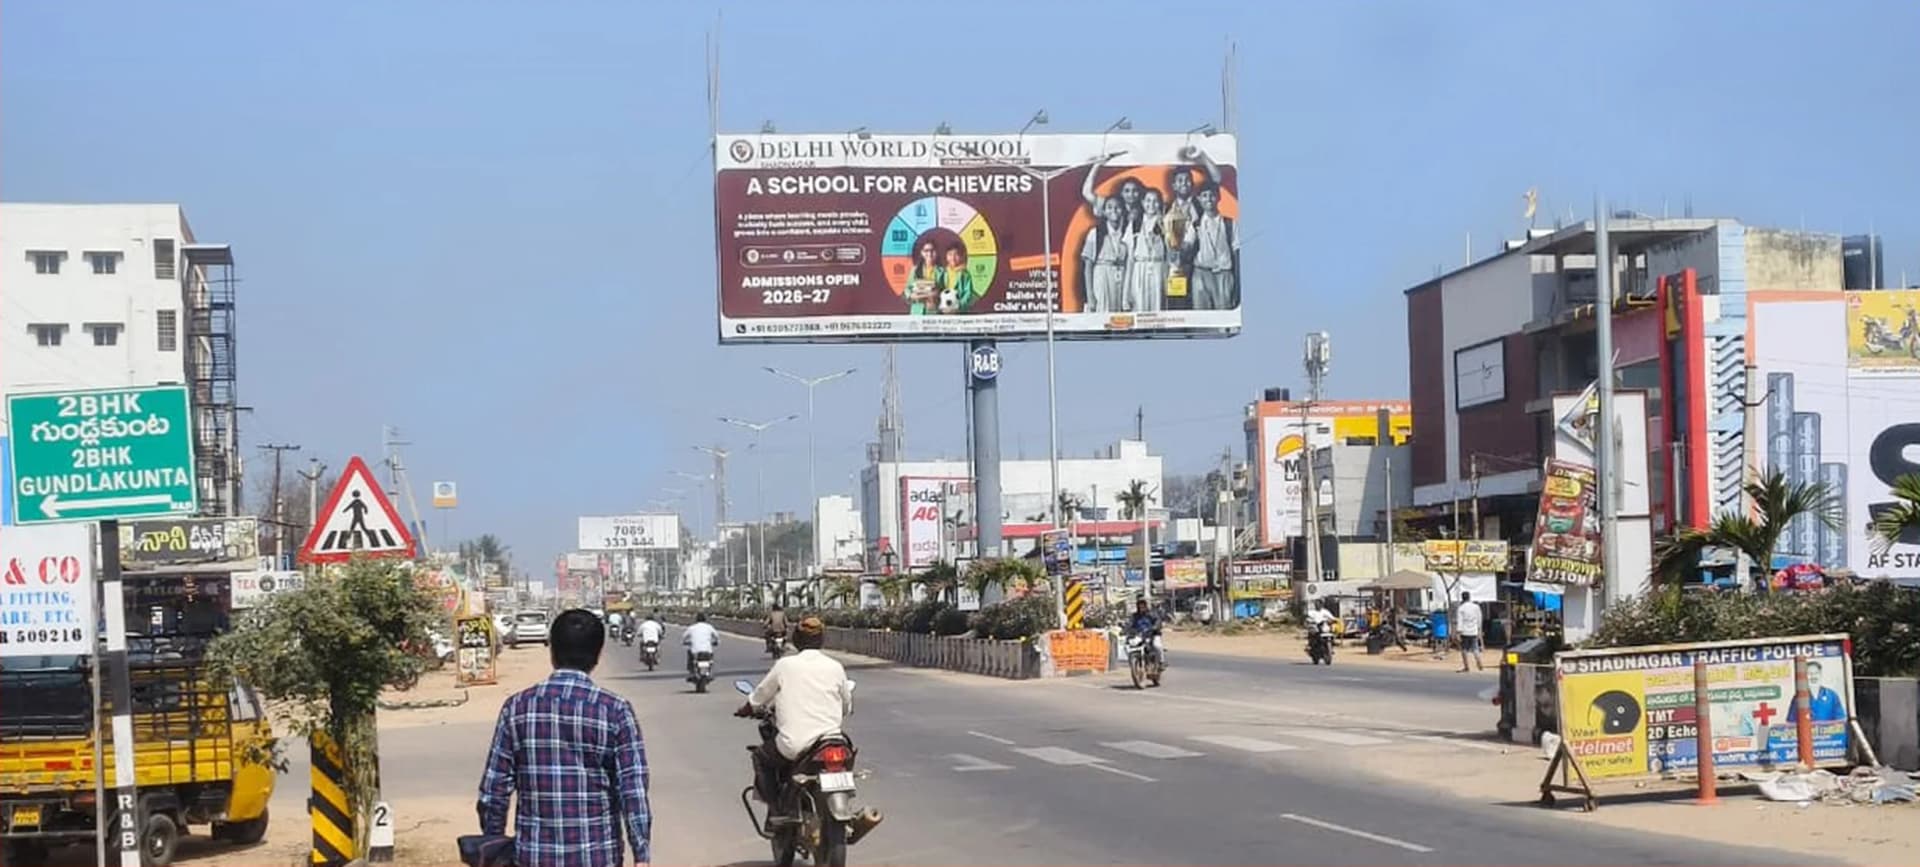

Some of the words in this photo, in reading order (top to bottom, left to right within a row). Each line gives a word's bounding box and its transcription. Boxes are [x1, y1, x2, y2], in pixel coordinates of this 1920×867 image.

[759, 140, 834, 158] DELHI
[840, 140, 927, 158] WORLD
[934, 139, 1031, 158] SCHOOL
[747, 177, 763, 195] A
[768, 175, 860, 194] SCHOOL
[864, 175, 907, 193] FOR
[912, 173, 1033, 193] ACHIEVERS
[742, 275, 823, 288] ADMISSIONS
[825, 274, 860, 286] OPEN
[763, 289, 830, 304] 2026-27
[973, 354, 998, 373] R&B
[57, 393, 142, 418] 2BHK
[71, 445, 133, 469] 2BHK
[19, 466, 190, 496] GUNDLAKUNTA
[38, 556, 81, 585] CO
[16, 629, 82, 642] 509216
[1578, 653, 1682, 673] SHADNAGAR
[1686, 649, 1757, 667] TRAFFIC
[1761, 643, 1824, 660] POLICE
[1647, 709, 1675, 722] TMT
[1648, 726, 1664, 739] 2D
[1667, 724, 1698, 738] Echo
[1572, 739, 1633, 755] Helmet
[1648, 743, 1675, 757] ECG
[375, 806, 388, 827] 2
